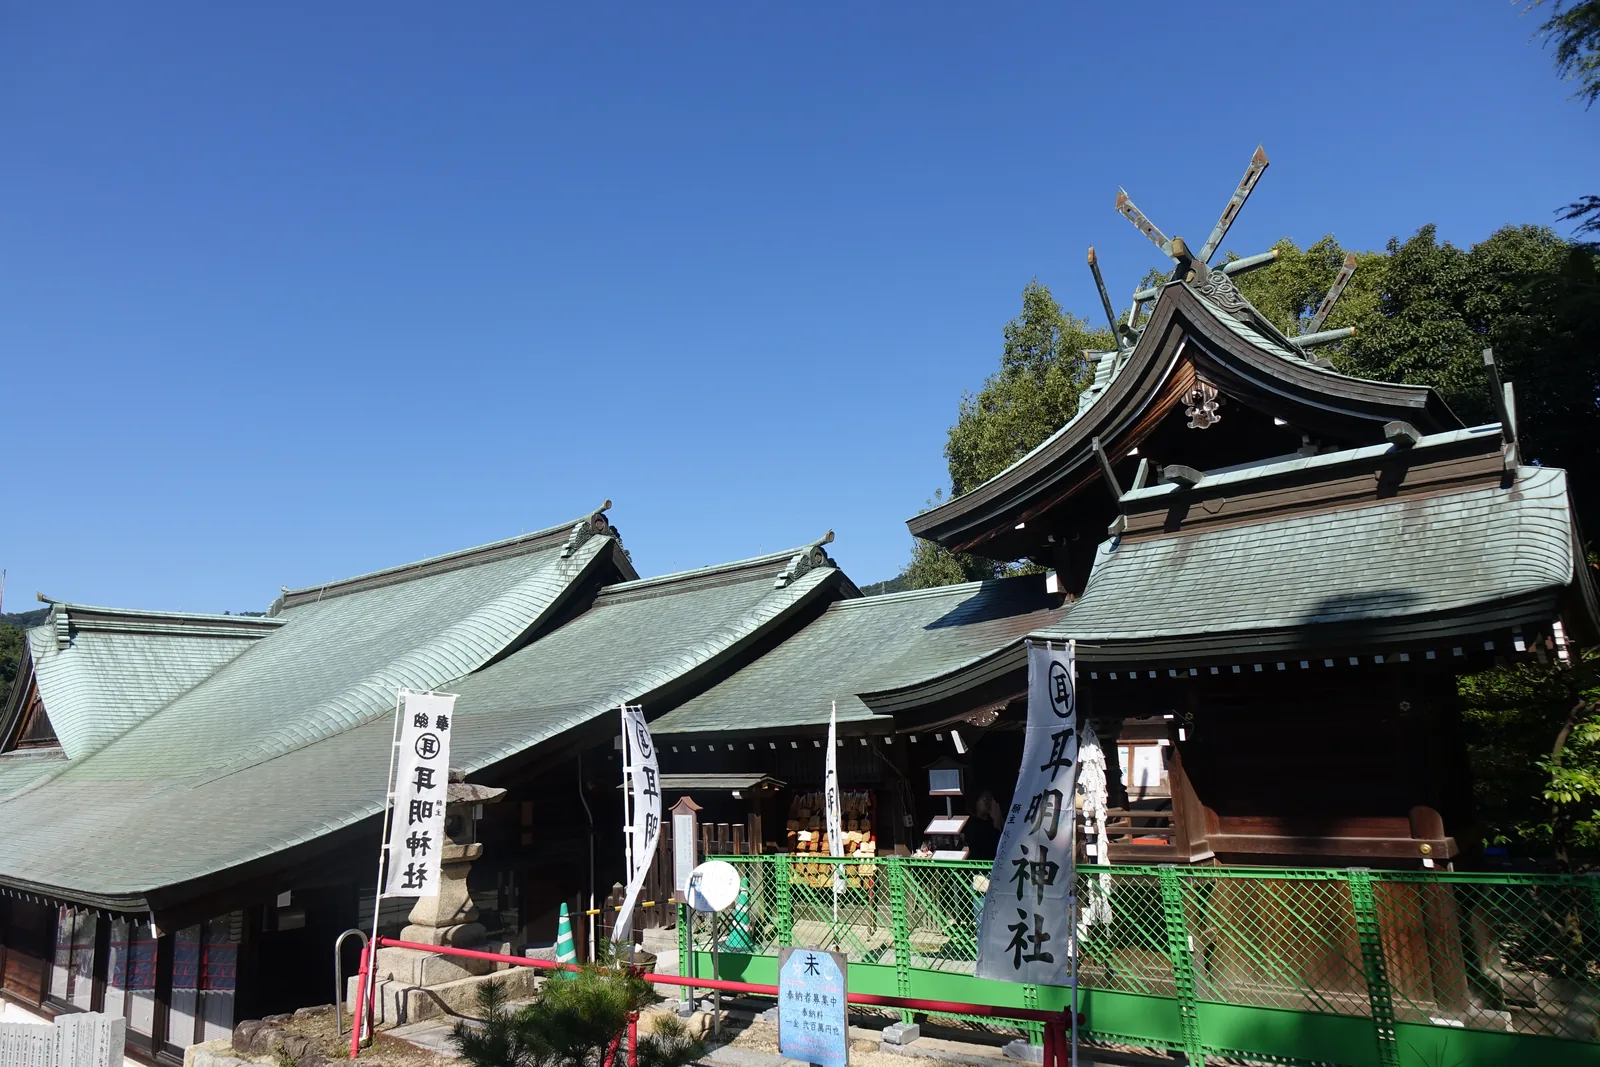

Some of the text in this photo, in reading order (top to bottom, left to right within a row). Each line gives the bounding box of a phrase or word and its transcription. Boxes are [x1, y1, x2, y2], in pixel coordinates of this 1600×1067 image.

[1005, 727, 1074, 970] 耳明神社
[787, 990, 837, 1007] 奉納者募集中
